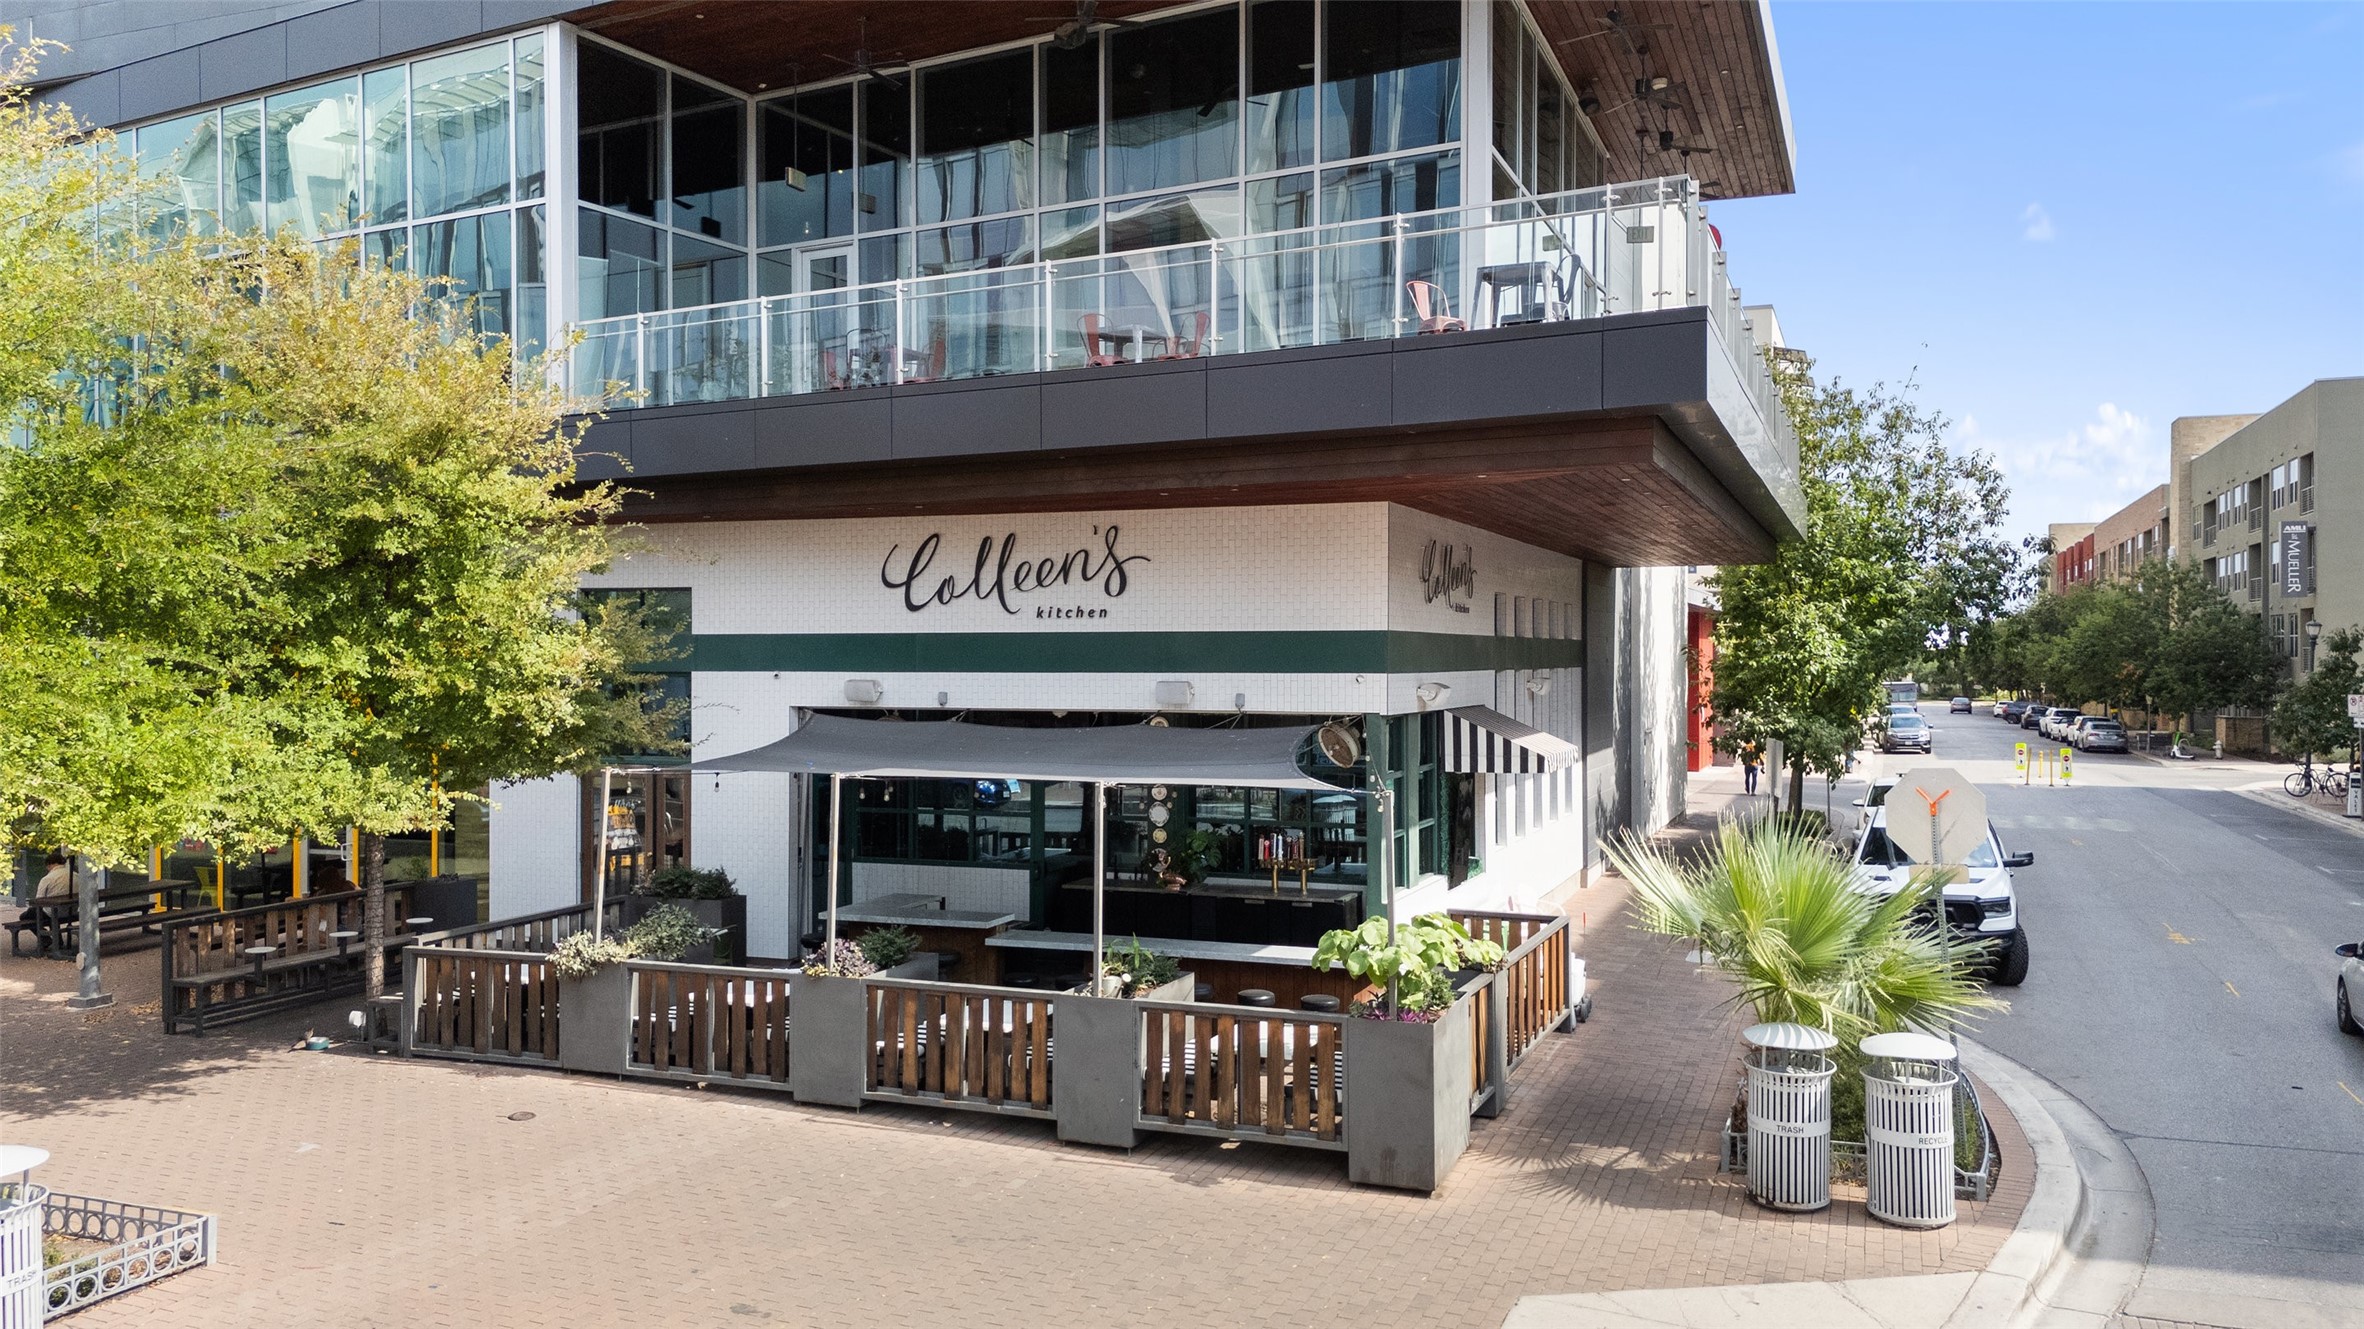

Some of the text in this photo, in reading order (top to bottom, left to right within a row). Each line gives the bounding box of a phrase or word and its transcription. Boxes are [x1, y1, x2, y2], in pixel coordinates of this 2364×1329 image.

[881, 525, 1151, 614] Colleen's
[2287, 540, 2301, 593] MUELLER
[1036, 606, 1108, 618] kitchen
[1776, 1124, 1804, 1134] TRASH
[1918, 1136, 1948, 1145] RECYCLE
